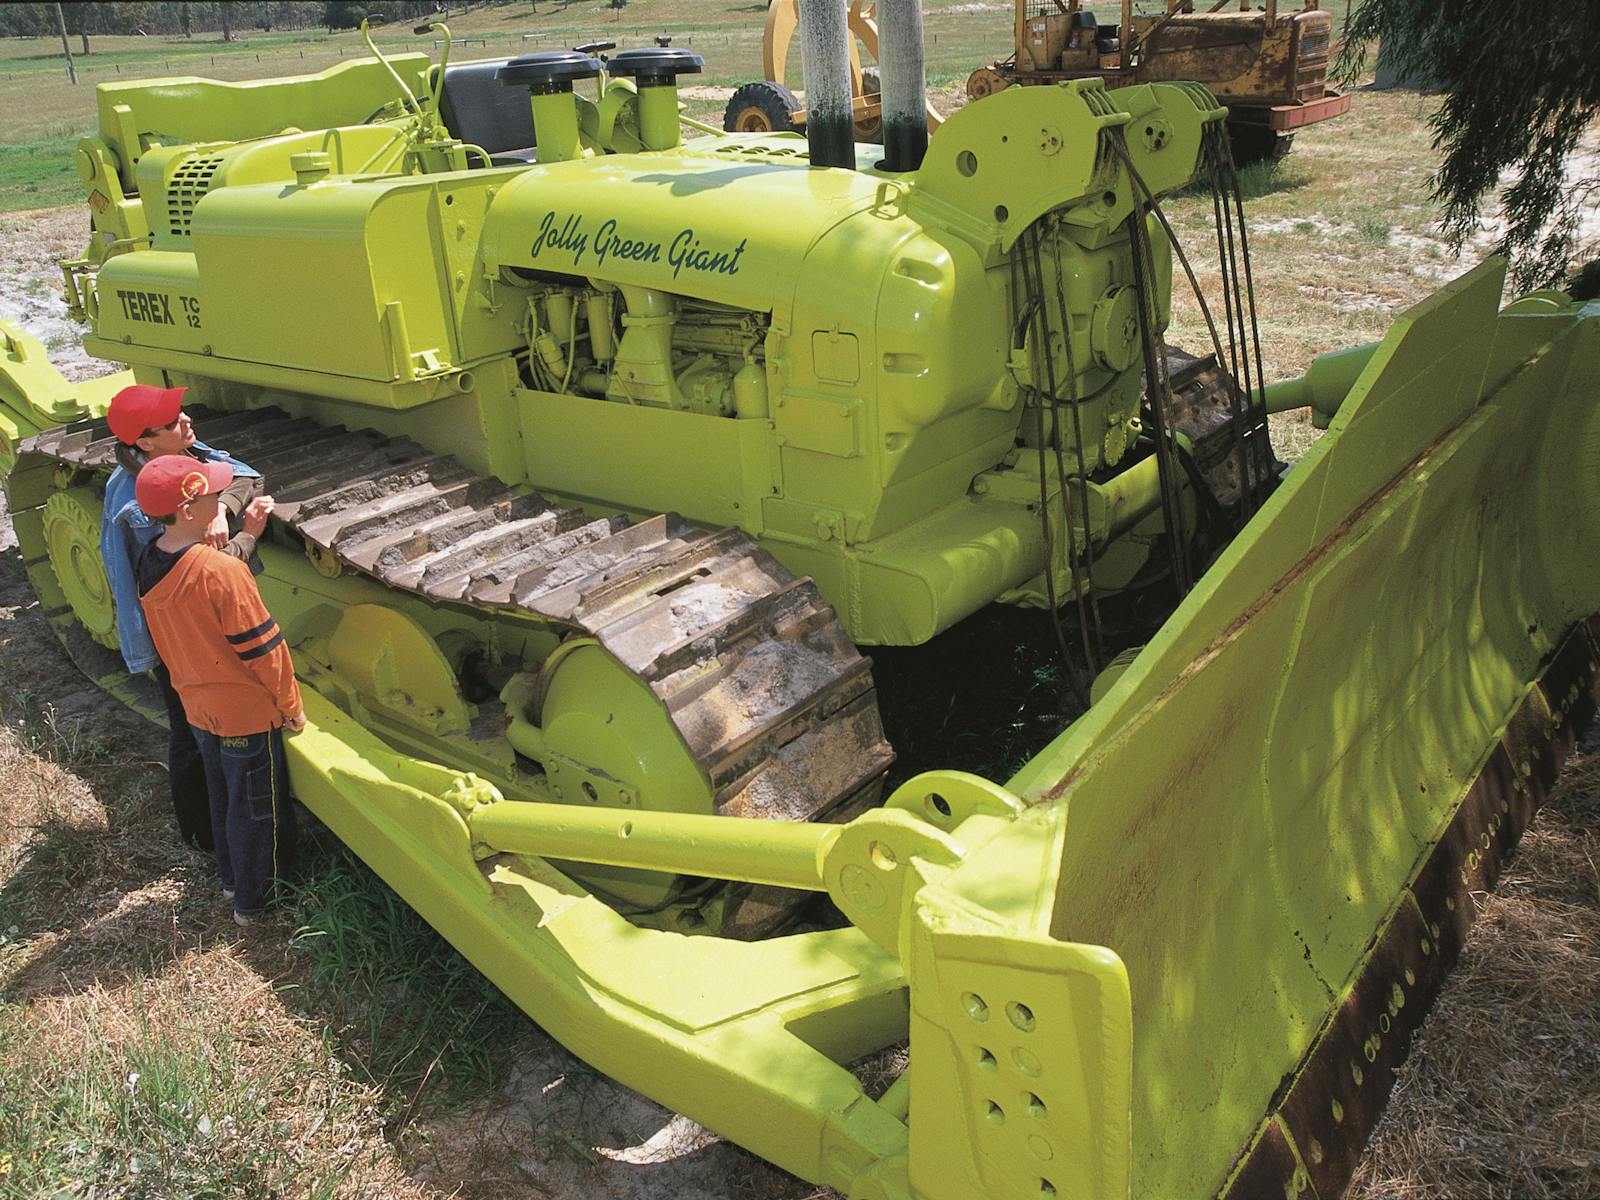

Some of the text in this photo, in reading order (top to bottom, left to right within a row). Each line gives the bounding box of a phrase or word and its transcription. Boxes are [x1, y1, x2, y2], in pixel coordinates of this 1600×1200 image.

[531, 211, 748, 280] Jolly Green Giant
[117, 290, 200, 325] TEREX TC
[187, 314, 201, 328] 12
